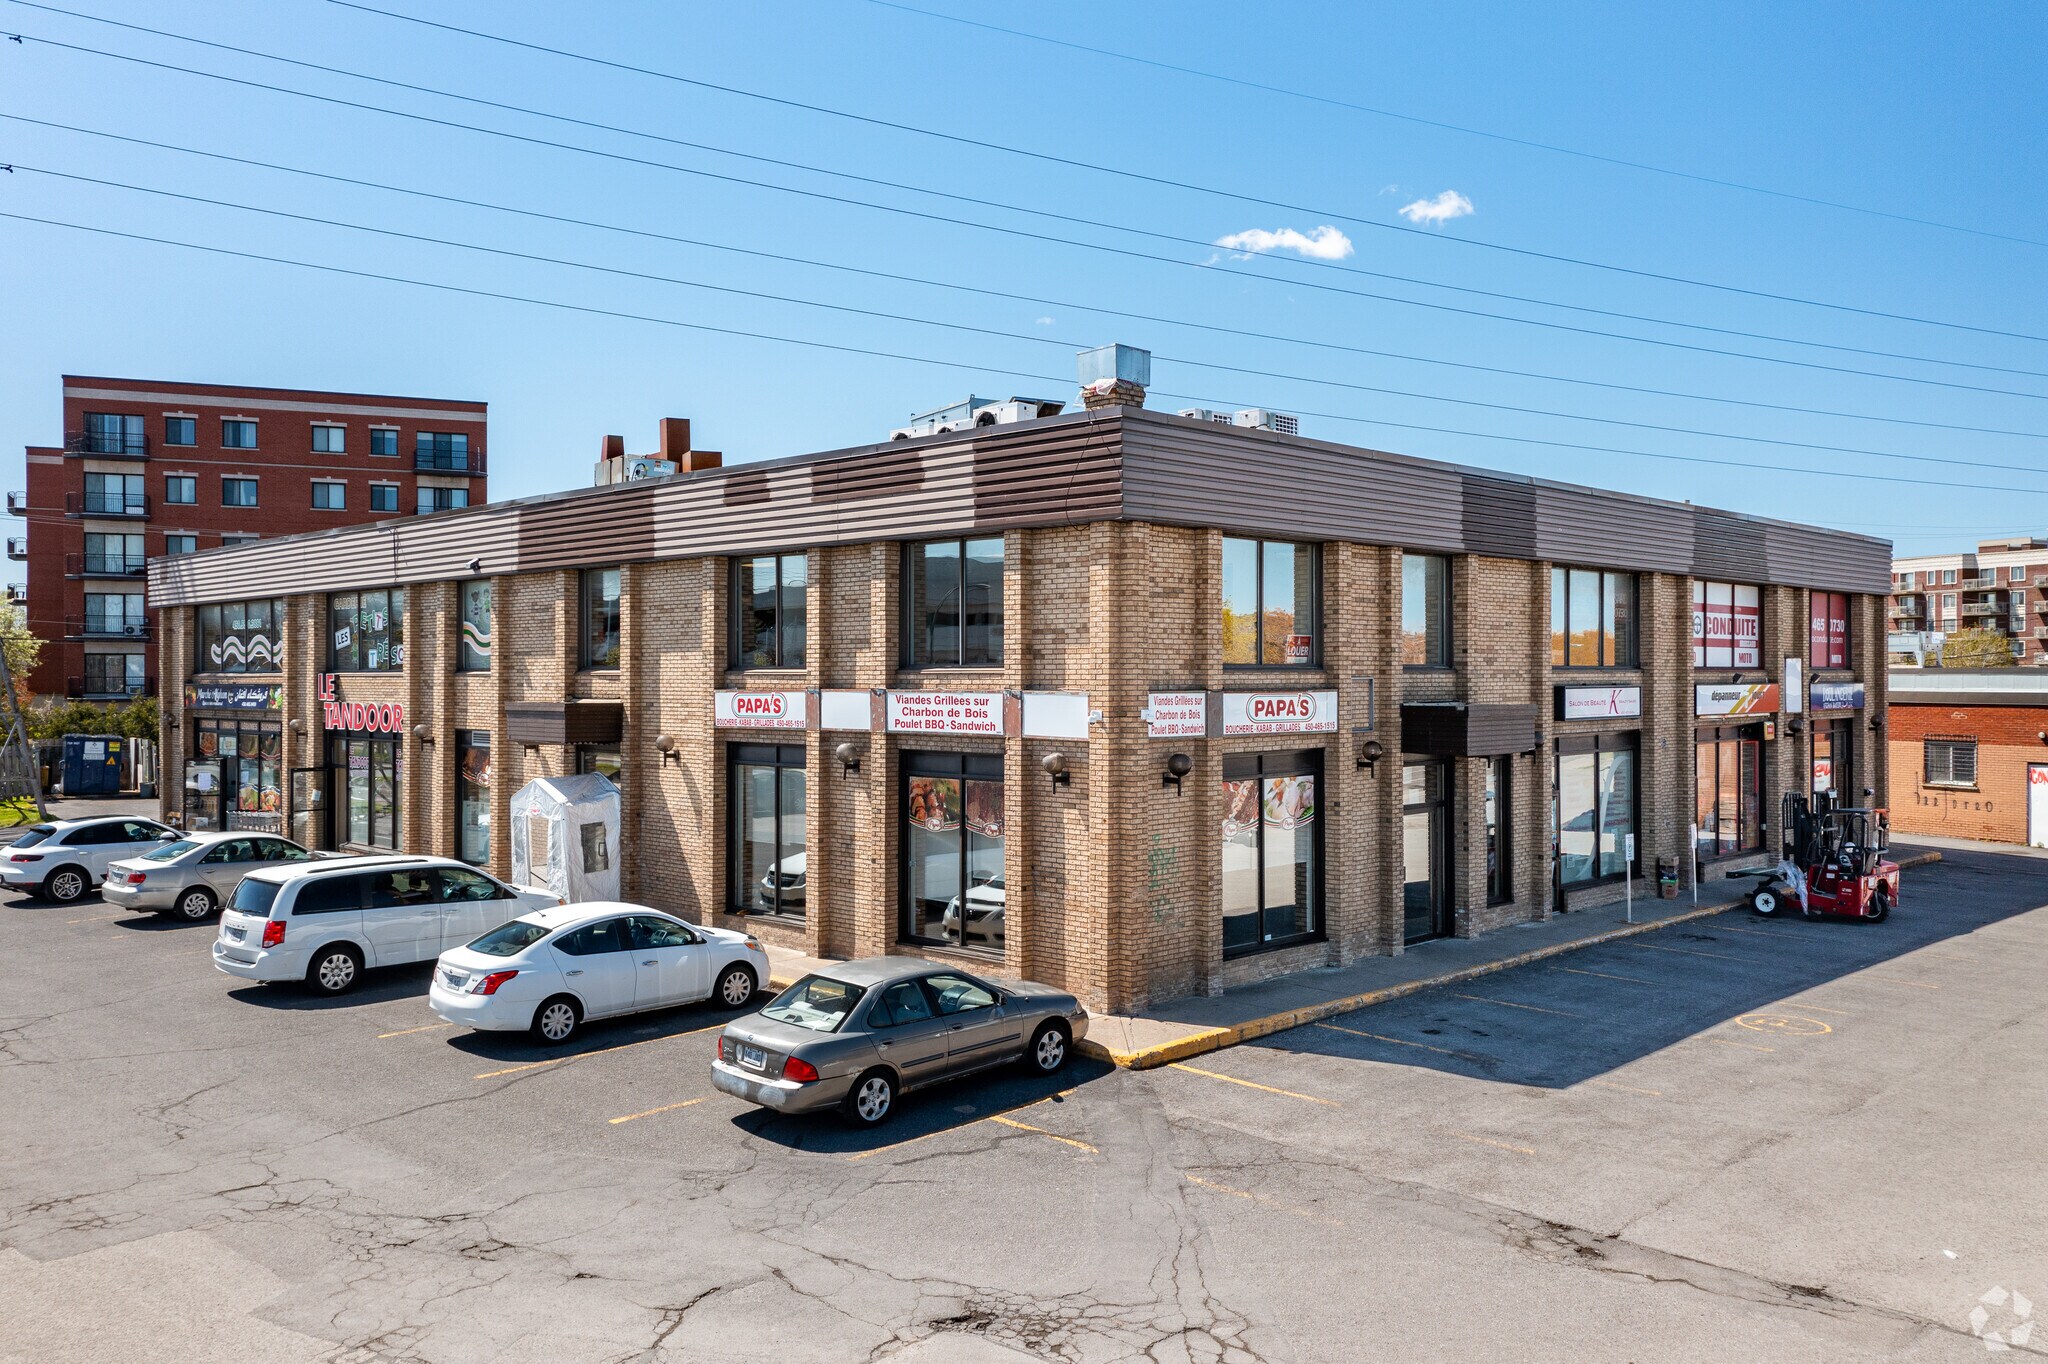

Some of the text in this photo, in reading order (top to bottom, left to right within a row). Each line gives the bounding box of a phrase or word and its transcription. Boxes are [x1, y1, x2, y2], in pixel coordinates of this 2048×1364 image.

[1705, 617, 1756, 636] CONDUITE
[1812, 618, 1845, 632] 465 0730
[337, 631, 348, 645] LES
[1287, 646, 1309, 656] LOUER
[1738, 653, 1753, 663] MOTO
[318, 673, 335, 701] LE
[1822, 686, 1853, 701] BOULANGERIE
[895, 695, 990, 706] Viandes Grillées sur
[1153, 695, 1173, 705] Viandes
[1175, 695, 1193, 705] Grillées
[1609, 689, 1623, 714] K
[1711, 689, 1741, 703] dépanneur
[737, 693, 781, 714] PAPA'S
[1254, 694, 1309, 718] PAPA'S
[323, 702, 404, 733] TANDOOR
[902, 707, 988, 718] Charbon de Bois
[1155, 709, 1201, 720] Charbon de Bois
[716, 718, 737, 726] BOUCHERIE
[754, 719, 775, 727] GRILLADES
[895, 719, 922, 729] Poulet
[950, 720, 996, 731] Sandwich
[1151, 724, 1167, 734] Poulet
[1225, 725, 1254, 734] BOUCHERIE
[1256, 724, 1272, 732] KABAB
[1276, 723, 1301, 732] GRILLADES
[1305, 722, 1336, 730] 450-465-1515
